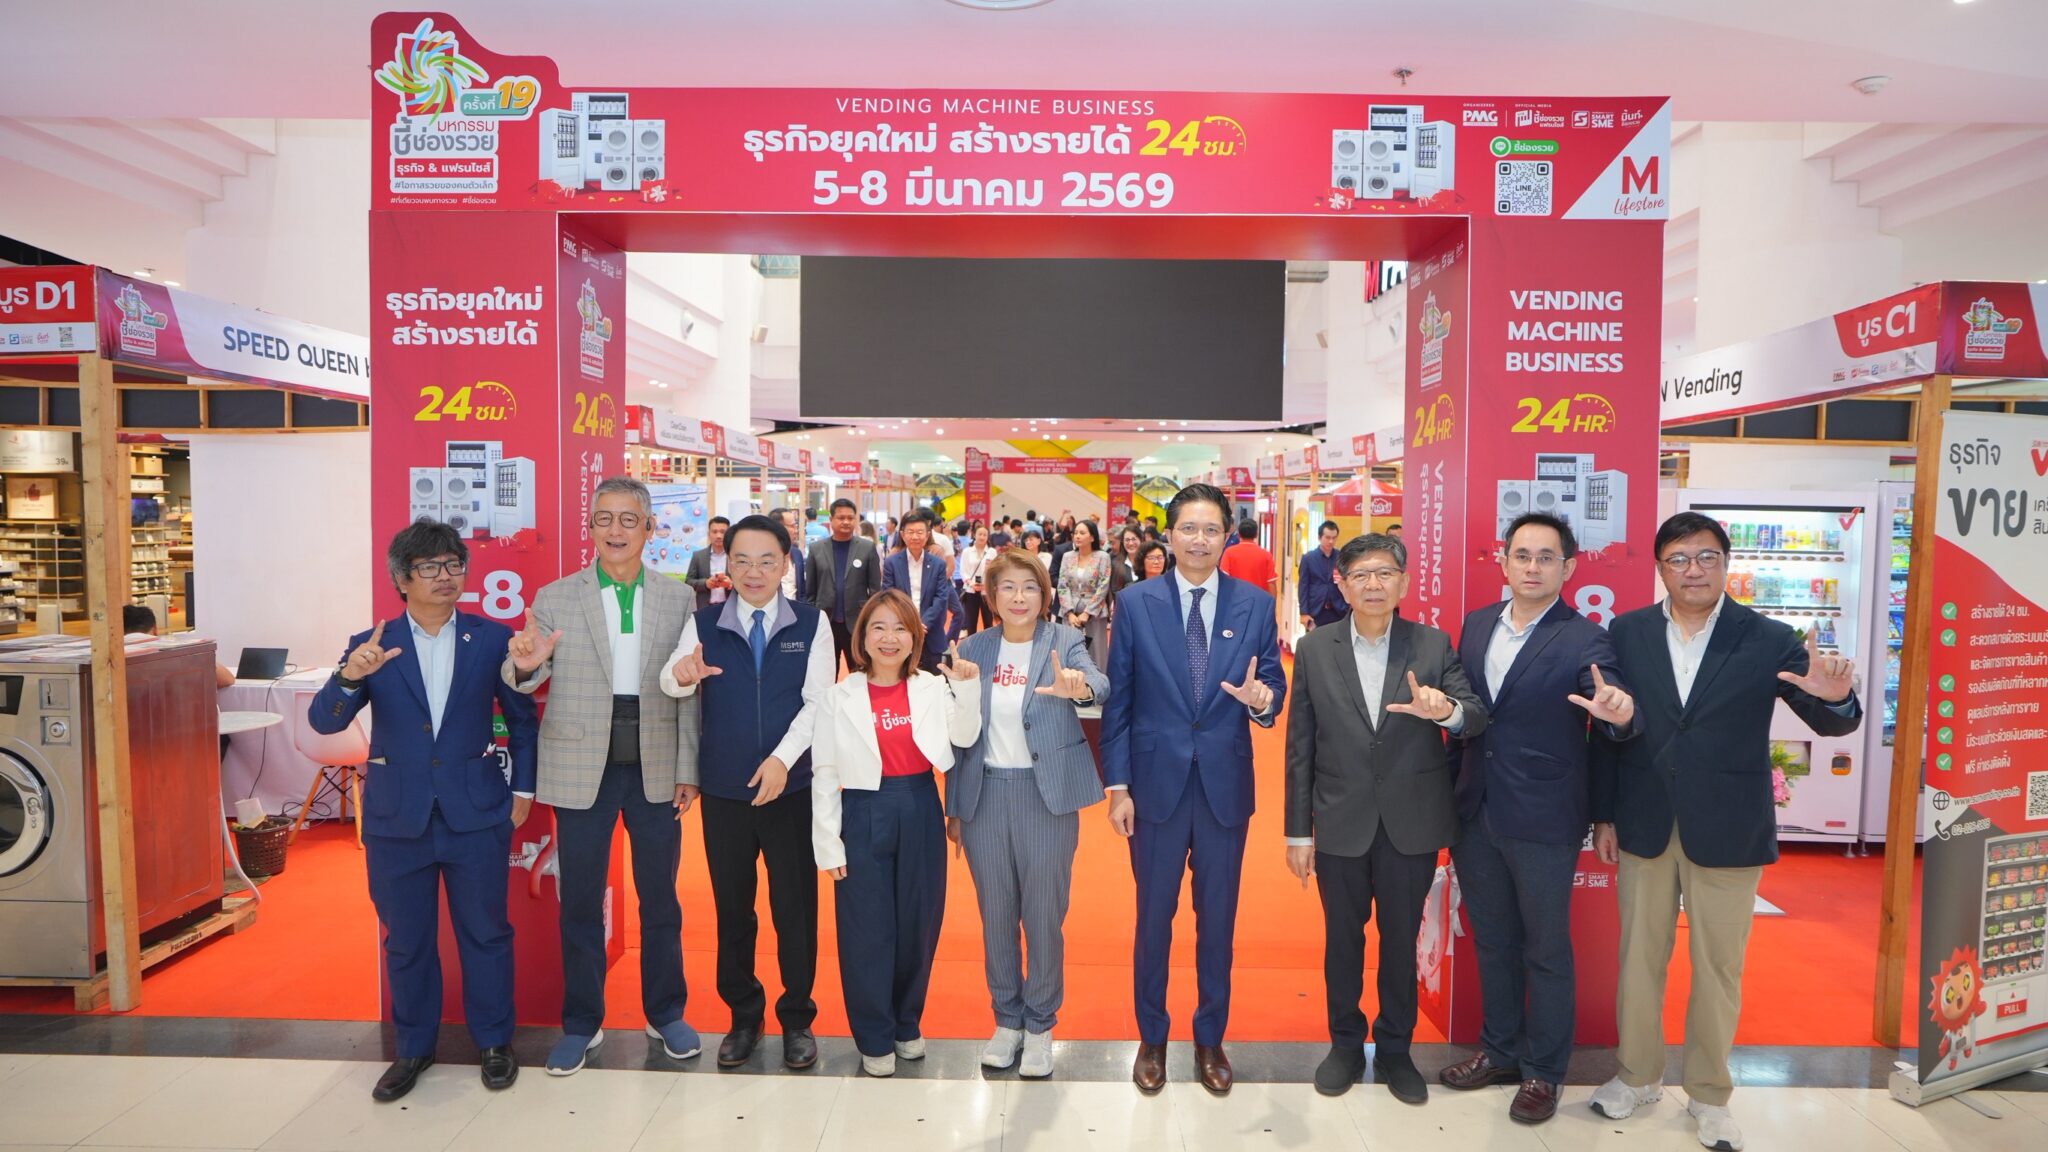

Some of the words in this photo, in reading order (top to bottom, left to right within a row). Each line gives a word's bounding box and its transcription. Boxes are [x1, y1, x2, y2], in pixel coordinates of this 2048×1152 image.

[464, 96, 495, 110] ครั้งที่
[499, 81, 536, 109] 19
[836, 97, 932, 114] VENDING
[943, 98, 1041, 115] MACHINE
[1053, 99, 1155, 116] BUSINESS
[438, 121, 494, 132] มหกรรม
[1463, 110, 1498, 122] PMG
[1592, 119, 1614, 128] SME
[394, 117, 494, 155] ชี้ช่องรวย
[744, 122, 937, 162] ธุรกิจยุคใหม่
[949, 121, 1130, 154] สร้างรายได้
[1140, 120, 1200, 156] 24
[1203, 140, 1238, 157] ชม.
[397, 162, 425, 176] ธุรกิจ
[428, 164, 437, 173] &
[442, 162, 491, 173] แฟรนไชส์
[1622, 156, 1659, 194] M
[813, 169, 887, 205] 5-8
[906, 166, 1043, 207] มีนาคม
[1061, 172, 1174, 209] 2569
[1614, 197, 1665, 216] Lifestore
[36, 280, 75, 310] D1
[386, 286, 543, 318] ธุรกิจยุคใหม่
[1510, 290, 1623, 310] VENDING
[393, 320, 538, 345] สร้างรายได้
[1508, 321, 1623, 342] MACHINE
[1886, 301, 1916, 338] C1
[223, 326, 289, 361] SPEED
[297, 344, 358, 376] QUEEN
[1506, 352, 1624, 373] BUSINESS
[1674, 367, 1742, 402] Vending
[414, 386, 472, 421] 24
[476, 405, 507, 421] ชม.
[573, 392, 598, 436] 24
[1511, 397, 1570, 433] 24
[1573, 415, 1608, 433] HR.
[1412, 403, 1436, 448] 24
[1949, 438, 2000, 474] ธุรกิจ
[1431, 460, 1444, 596] VENDING
[1947, 488, 2027, 538] ขาย
[456, 570, 525, 619] -8
[2006, 605, 2015, 617] 24
[1001, 664, 1028, 686] ชี้ช่อ
[881, 708, 912, 730] ชี้ช่อง
[1588, 880, 1608, 888] SME
[2004, 1003, 2020, 1015] PULL
